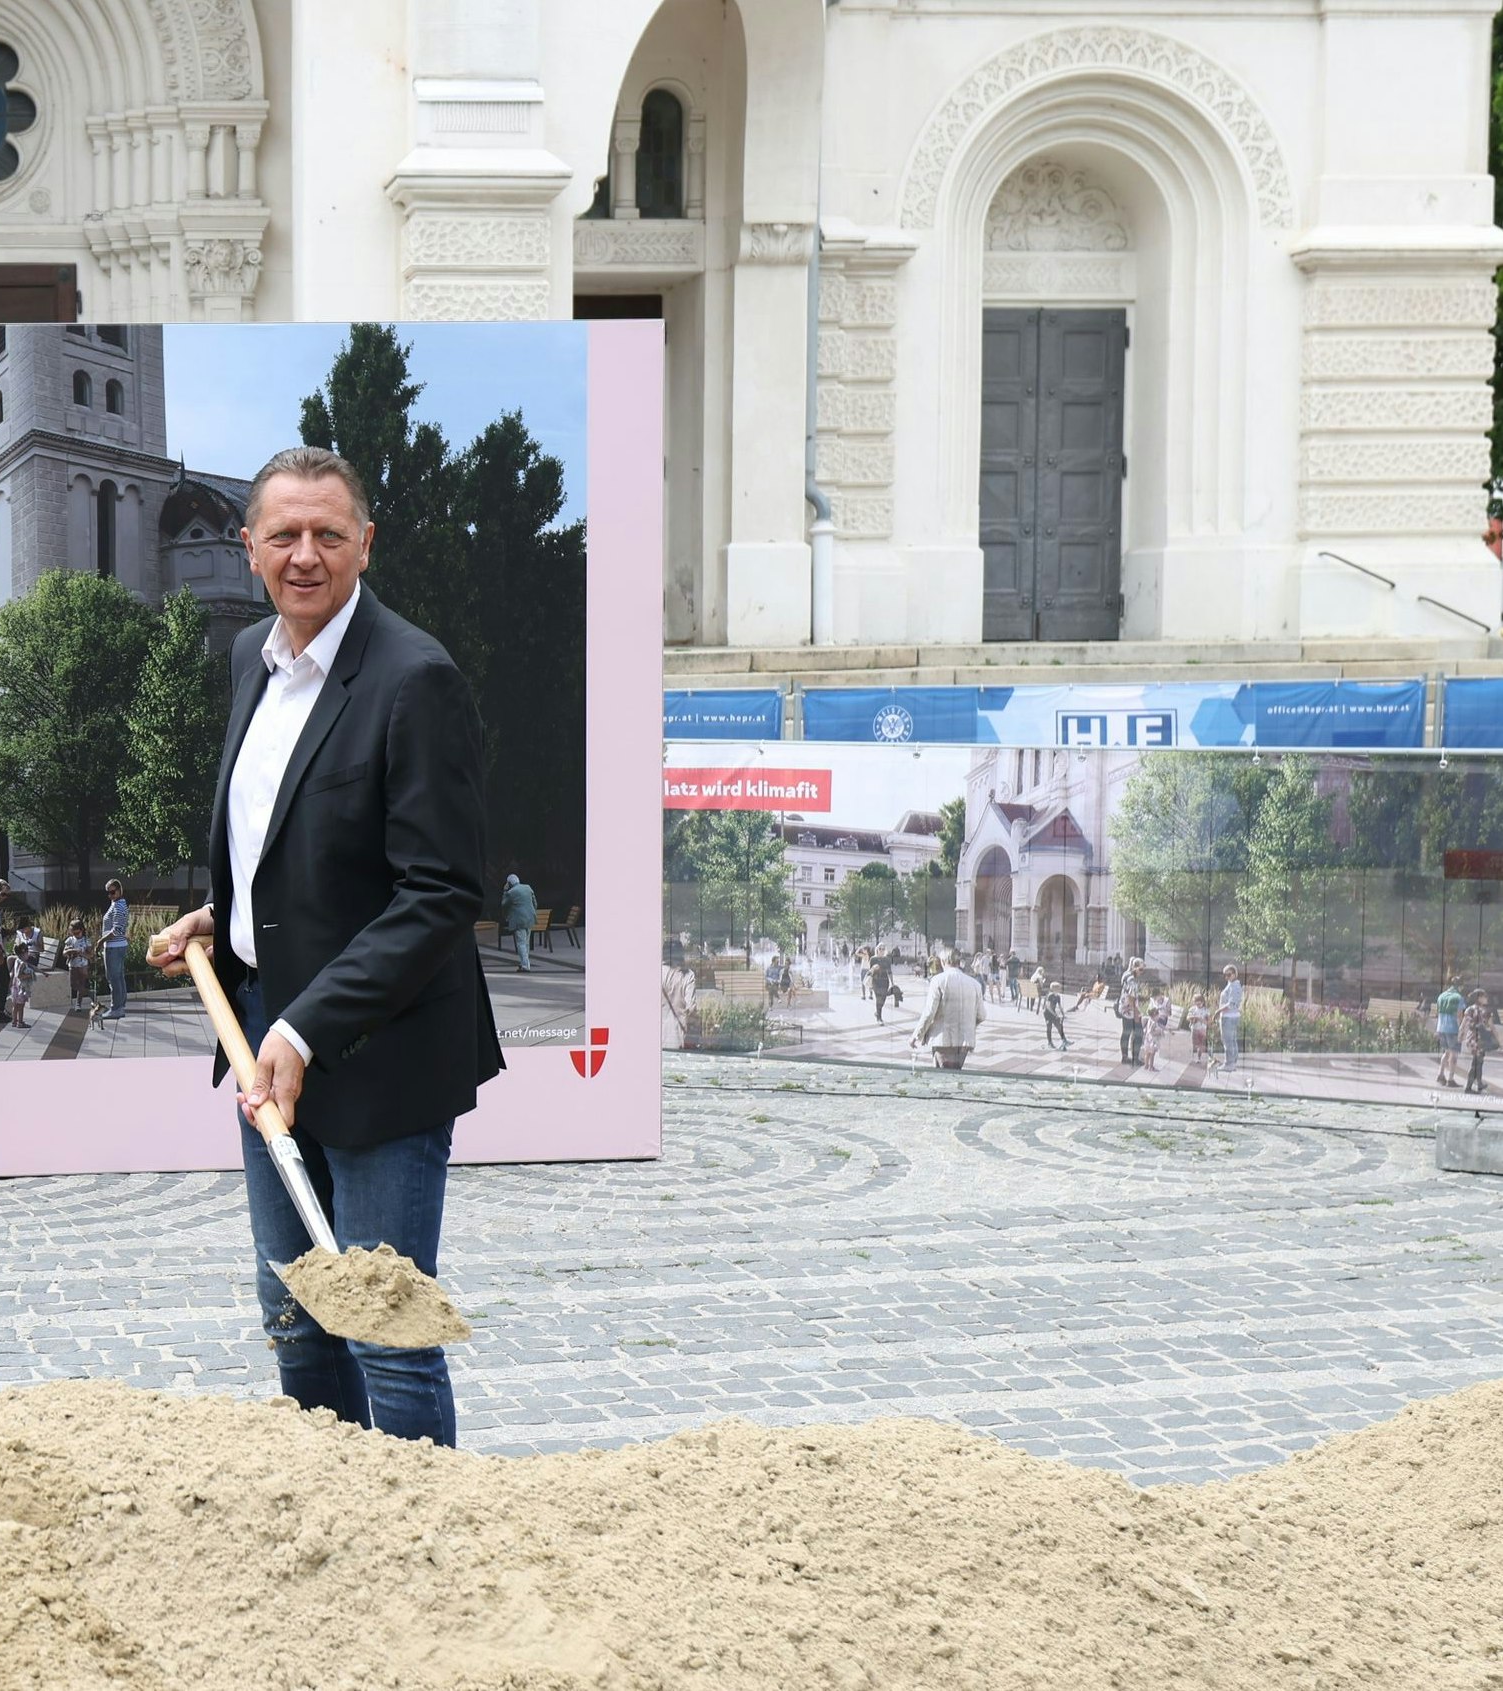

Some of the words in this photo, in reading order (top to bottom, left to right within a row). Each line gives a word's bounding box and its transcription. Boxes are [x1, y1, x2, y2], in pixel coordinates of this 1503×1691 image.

[702, 714, 766, 724] www.hepr.at
[701, 780, 742, 796] wird
[746, 780, 818, 799] klimafit
[497, 1026, 578, 1039] t.net/message
